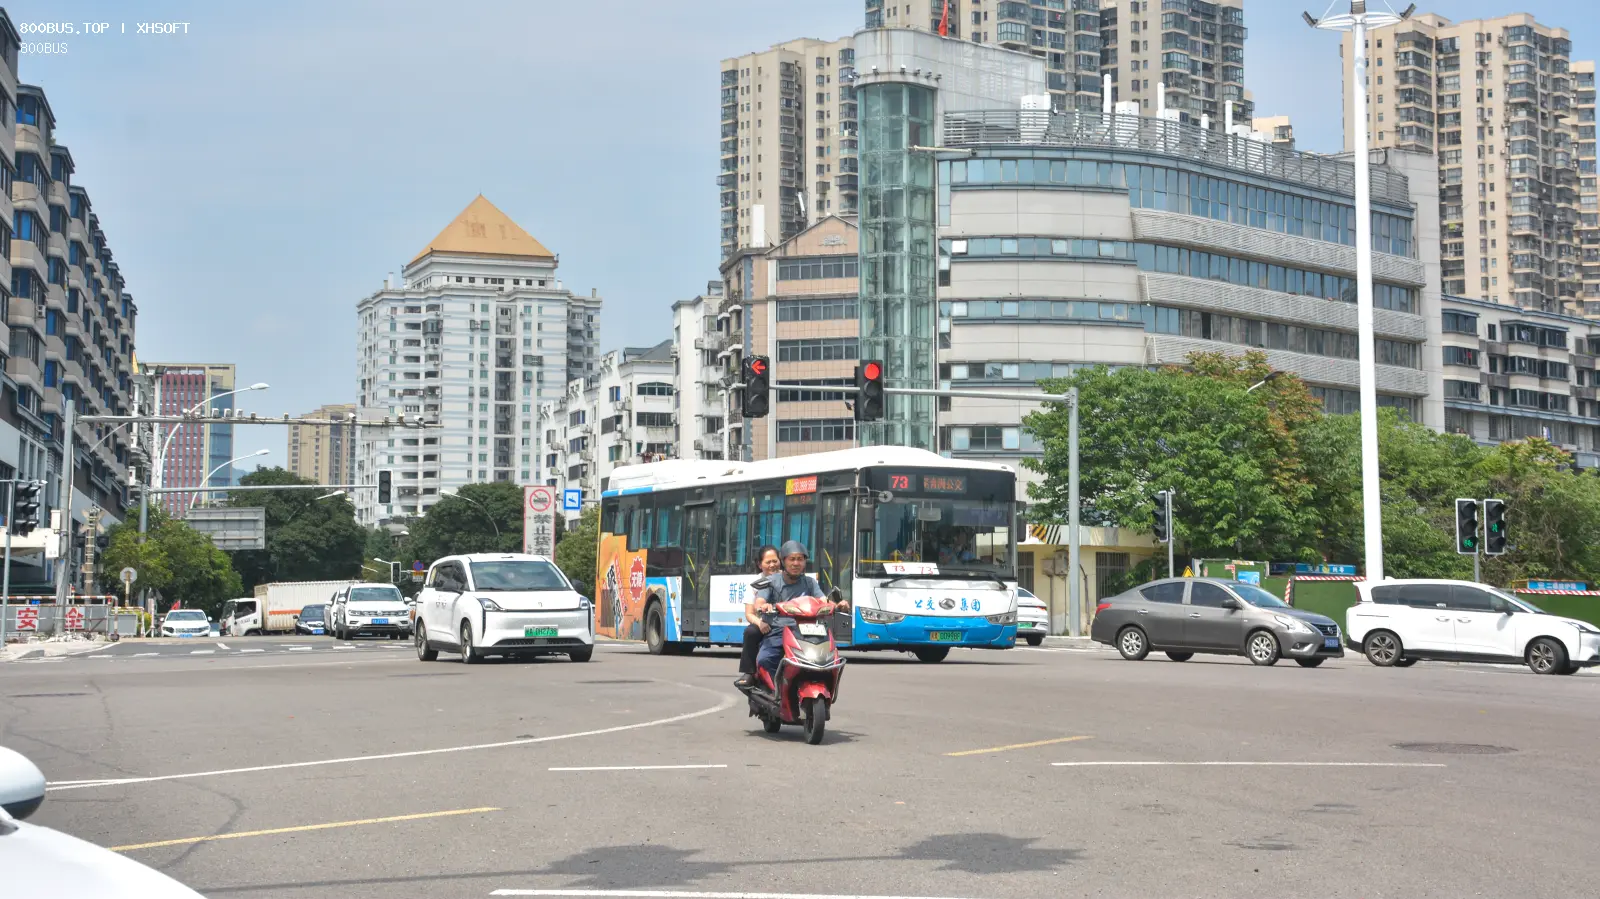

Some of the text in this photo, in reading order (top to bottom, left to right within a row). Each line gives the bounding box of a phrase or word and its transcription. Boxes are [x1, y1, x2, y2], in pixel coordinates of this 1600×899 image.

[891, 475, 909, 489] 73
[918, 566, 934, 575] 73
[914, 596, 981, 612] 公交 集团
